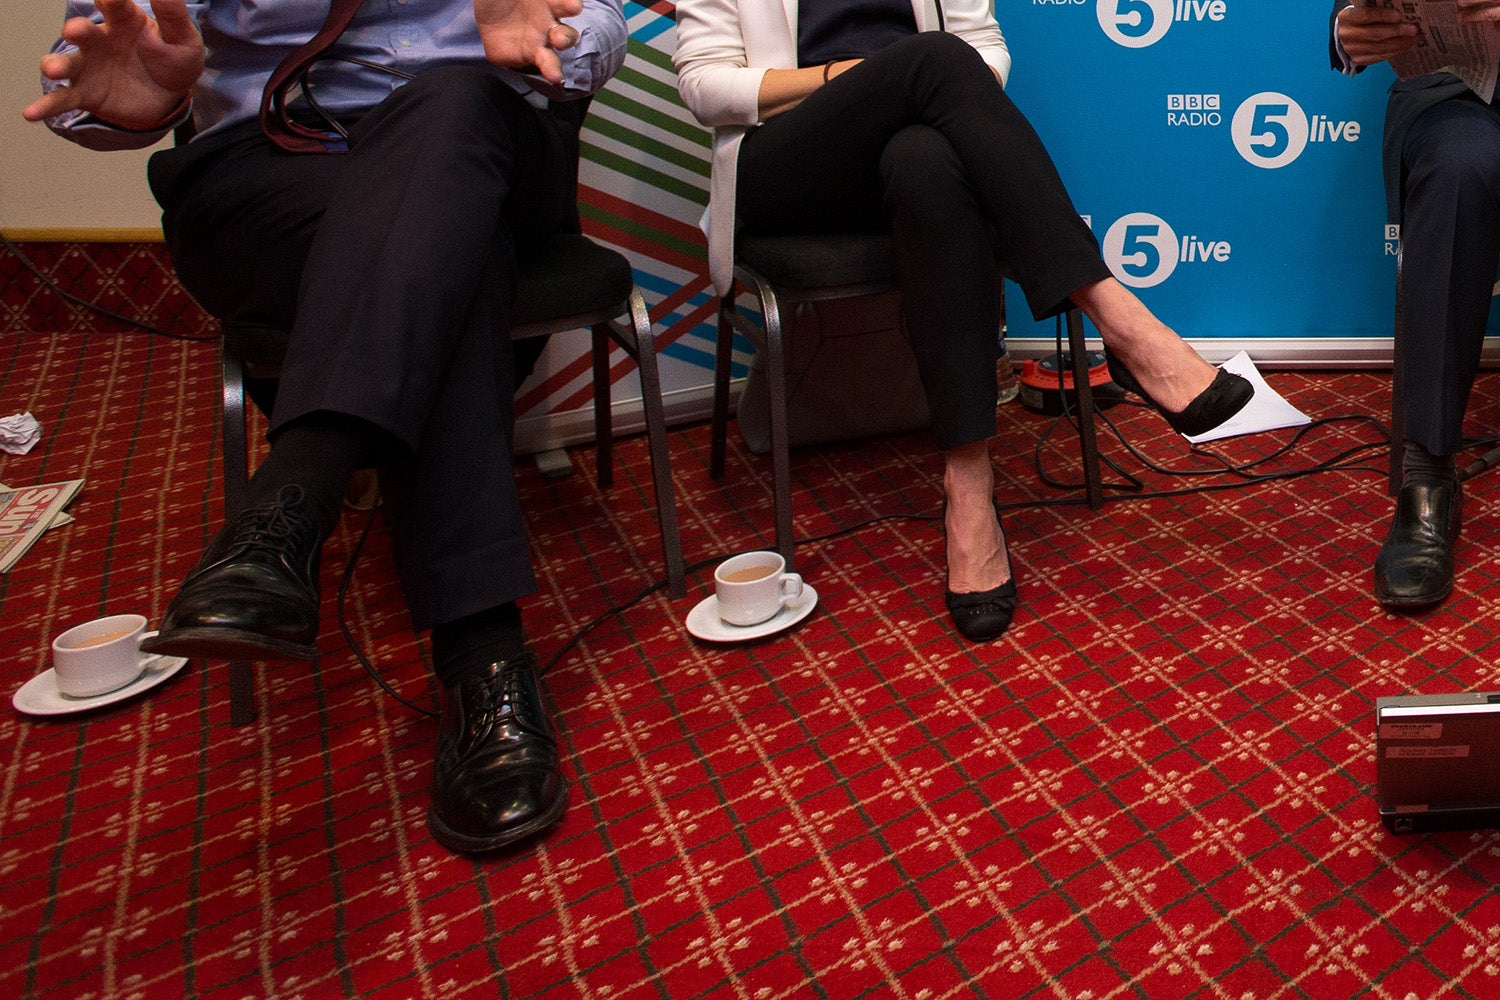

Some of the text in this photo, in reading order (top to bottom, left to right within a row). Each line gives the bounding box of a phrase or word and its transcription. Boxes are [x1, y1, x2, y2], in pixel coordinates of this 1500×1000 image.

[1167, 112, 1222, 126] RADIO
[1170, 96, 1219, 109] BBC
[1249, 105, 1360, 158] 5 live
[1121, 225, 1231, 278] 5 live
[0, 488, 58, 534] Sun
